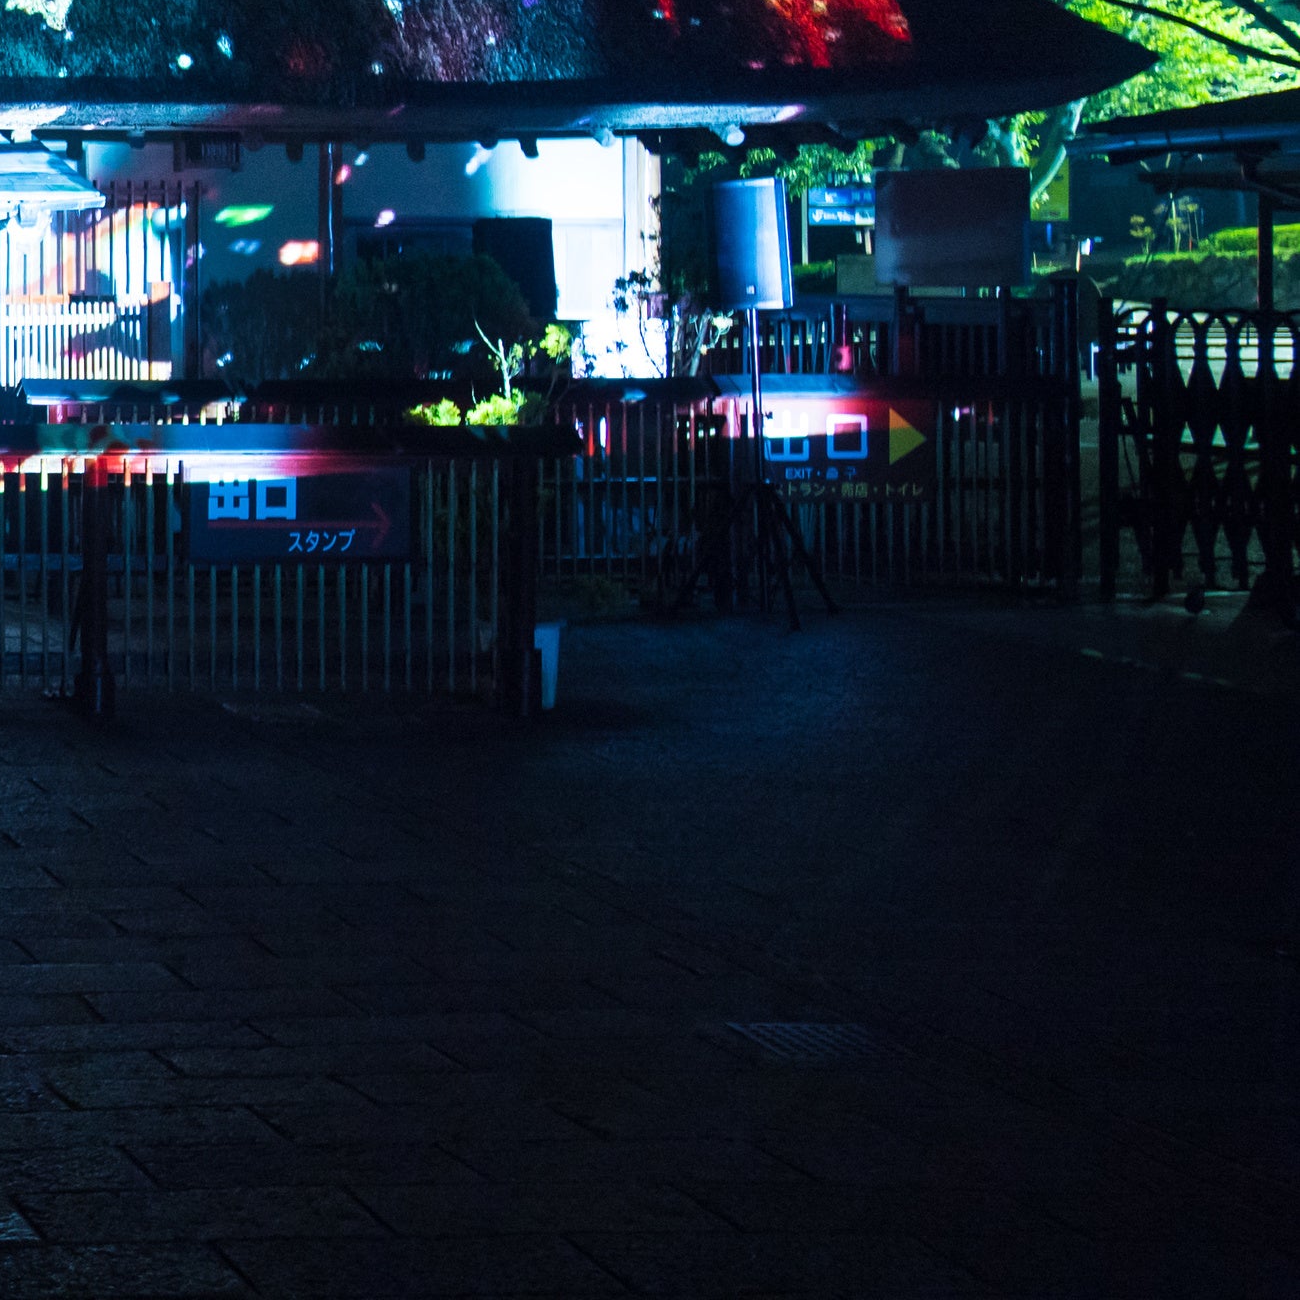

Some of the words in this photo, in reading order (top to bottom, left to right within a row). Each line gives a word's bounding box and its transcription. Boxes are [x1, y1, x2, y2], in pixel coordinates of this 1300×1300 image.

[763, 410, 867, 461] 出口
[208, 472, 297, 520] 出口
[288, 528, 356, 553] スタンプ
